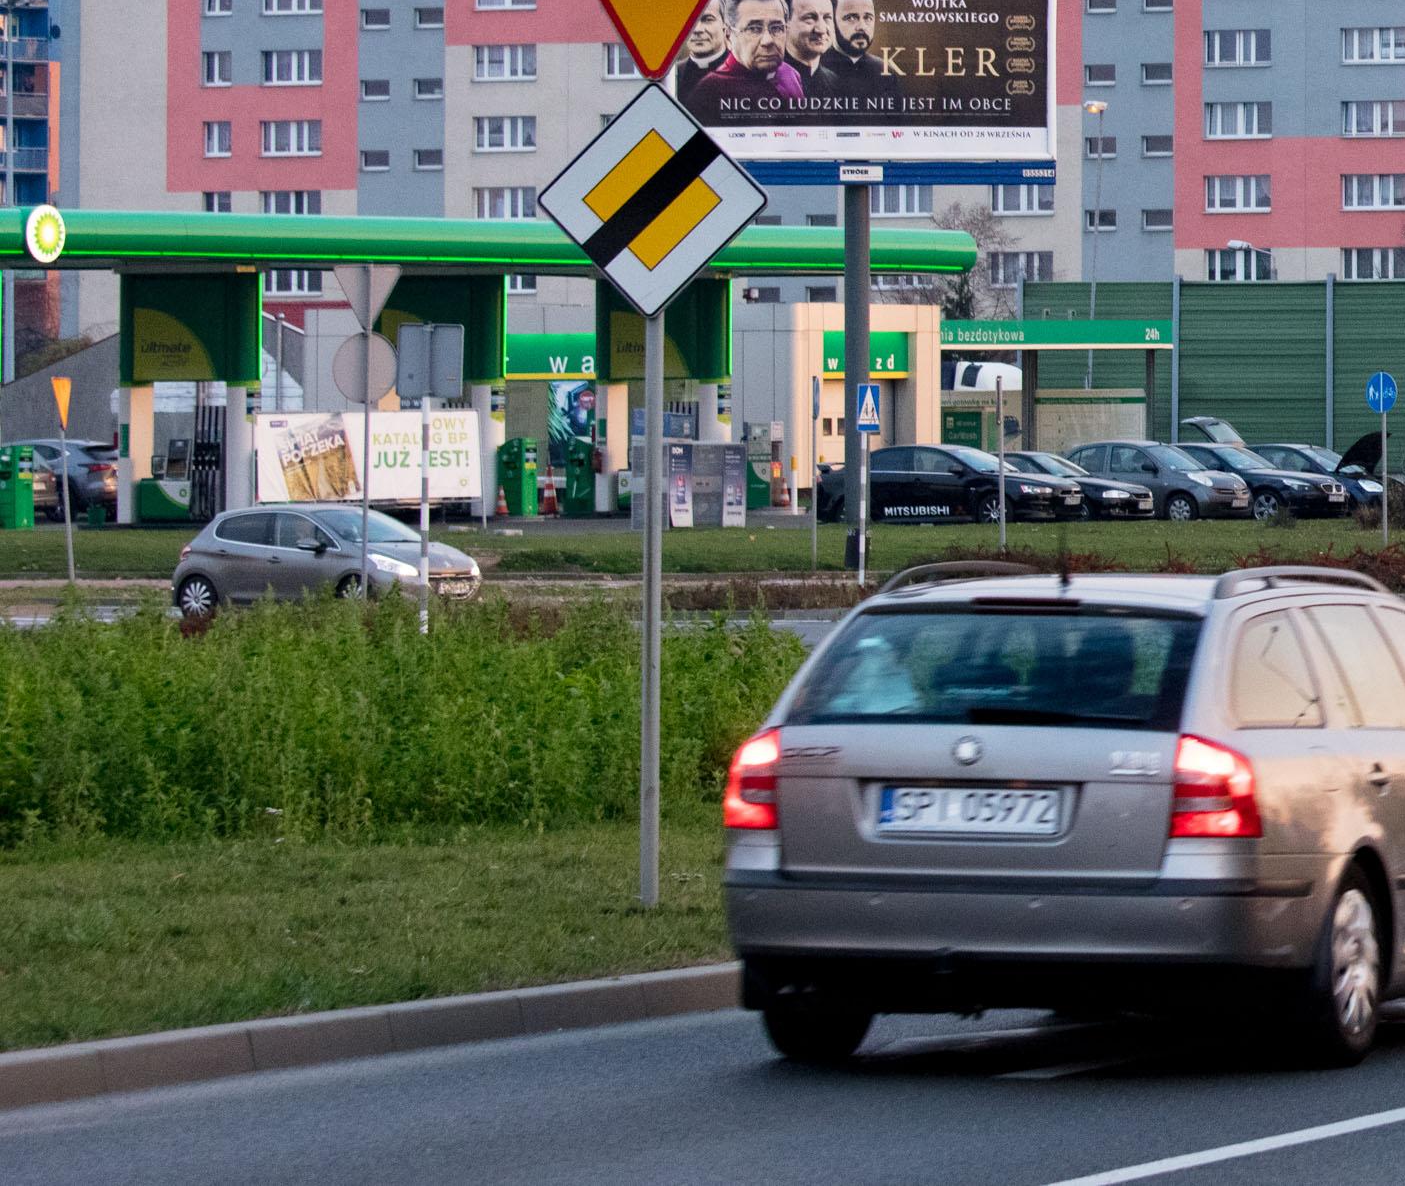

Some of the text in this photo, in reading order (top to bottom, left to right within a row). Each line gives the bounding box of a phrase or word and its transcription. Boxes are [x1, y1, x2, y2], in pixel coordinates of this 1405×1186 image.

[879, 12, 1000, 24] SMARZOWSKIEGO
[880, 46, 1001, 77] KLER
[720, 97, 1012, 112] NIC CO LUDZKIE NIE JEST IM OBCE
[913, 130, 921, 138] W
[923, 130, 958, 138] KINACH
[960, 130, 974, 138] OD
[976, 130, 985, 138] 28
[987, 130, 1032, 139] WRZEŚNIA
[957, 328, 1025, 345] bezdotykowa
[1145, 327, 1160, 341] 24h
[432, 417, 466, 430] OWY
[372, 432, 468, 446] KATALG BP
[373, 445, 411, 469] JUŻ
[884, 504, 950, 517] MITSUBISHI
